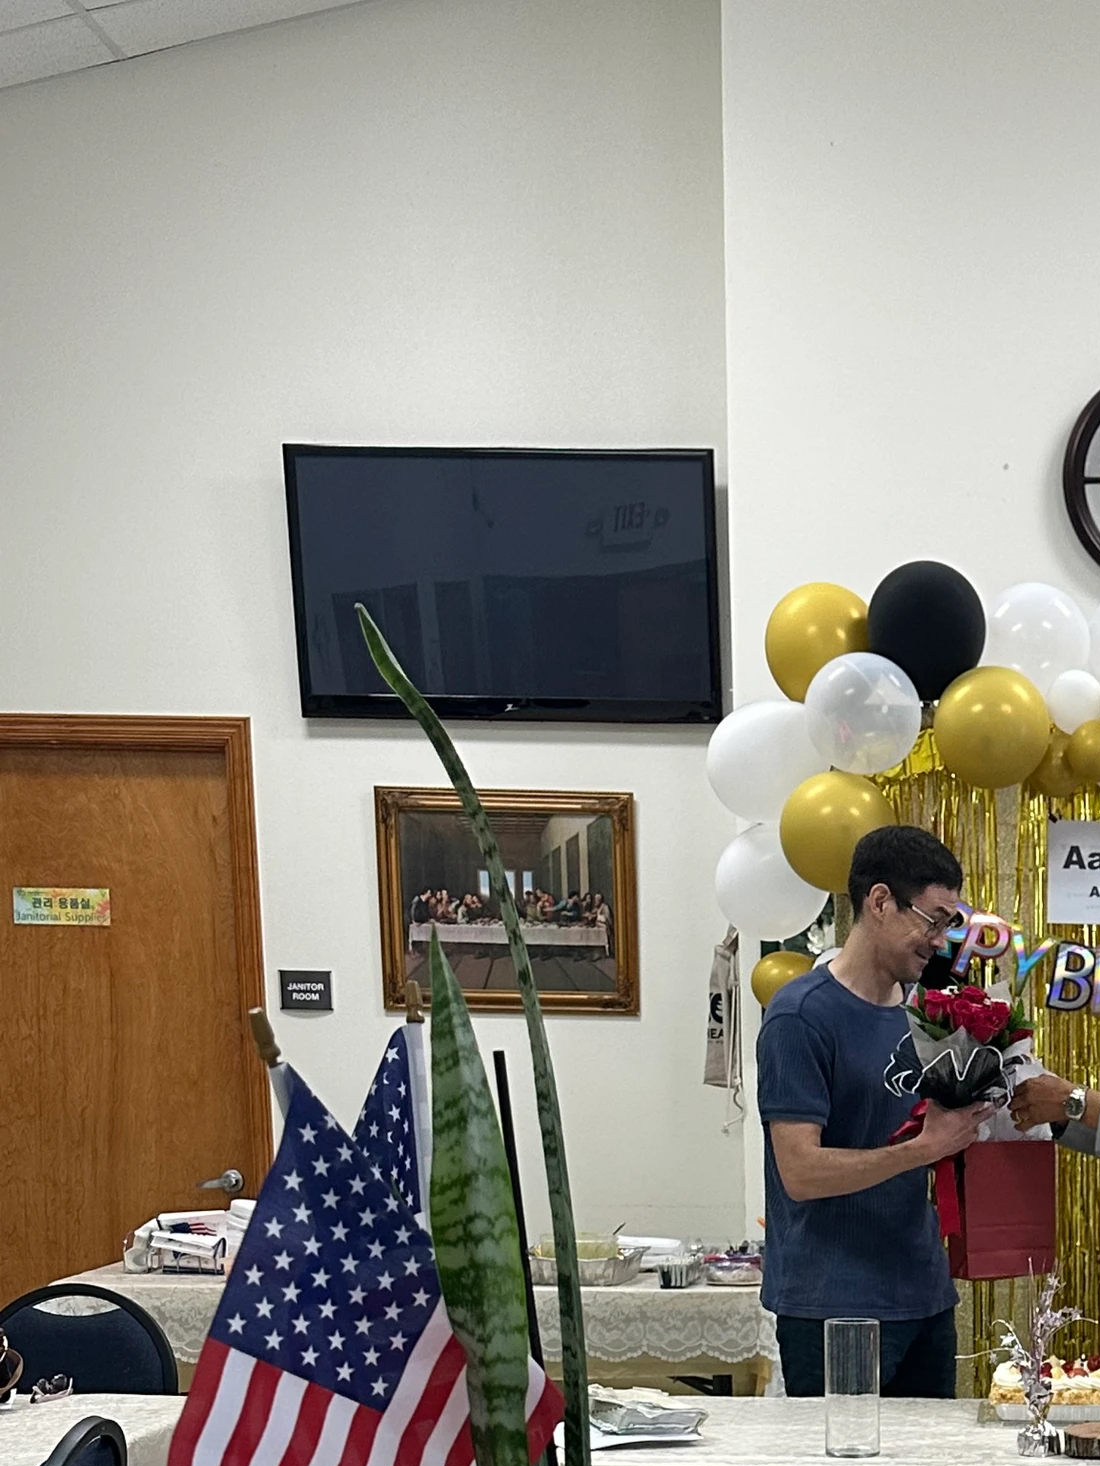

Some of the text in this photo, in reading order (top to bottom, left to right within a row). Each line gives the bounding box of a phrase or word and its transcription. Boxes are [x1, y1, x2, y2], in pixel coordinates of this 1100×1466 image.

[32, 897, 90, 910] 관리 용품실
[16, 911, 109, 923] Janitorial Supplies
[287, 982, 324, 991] JANITOR
[292, 992, 320, 1001] ROOM
